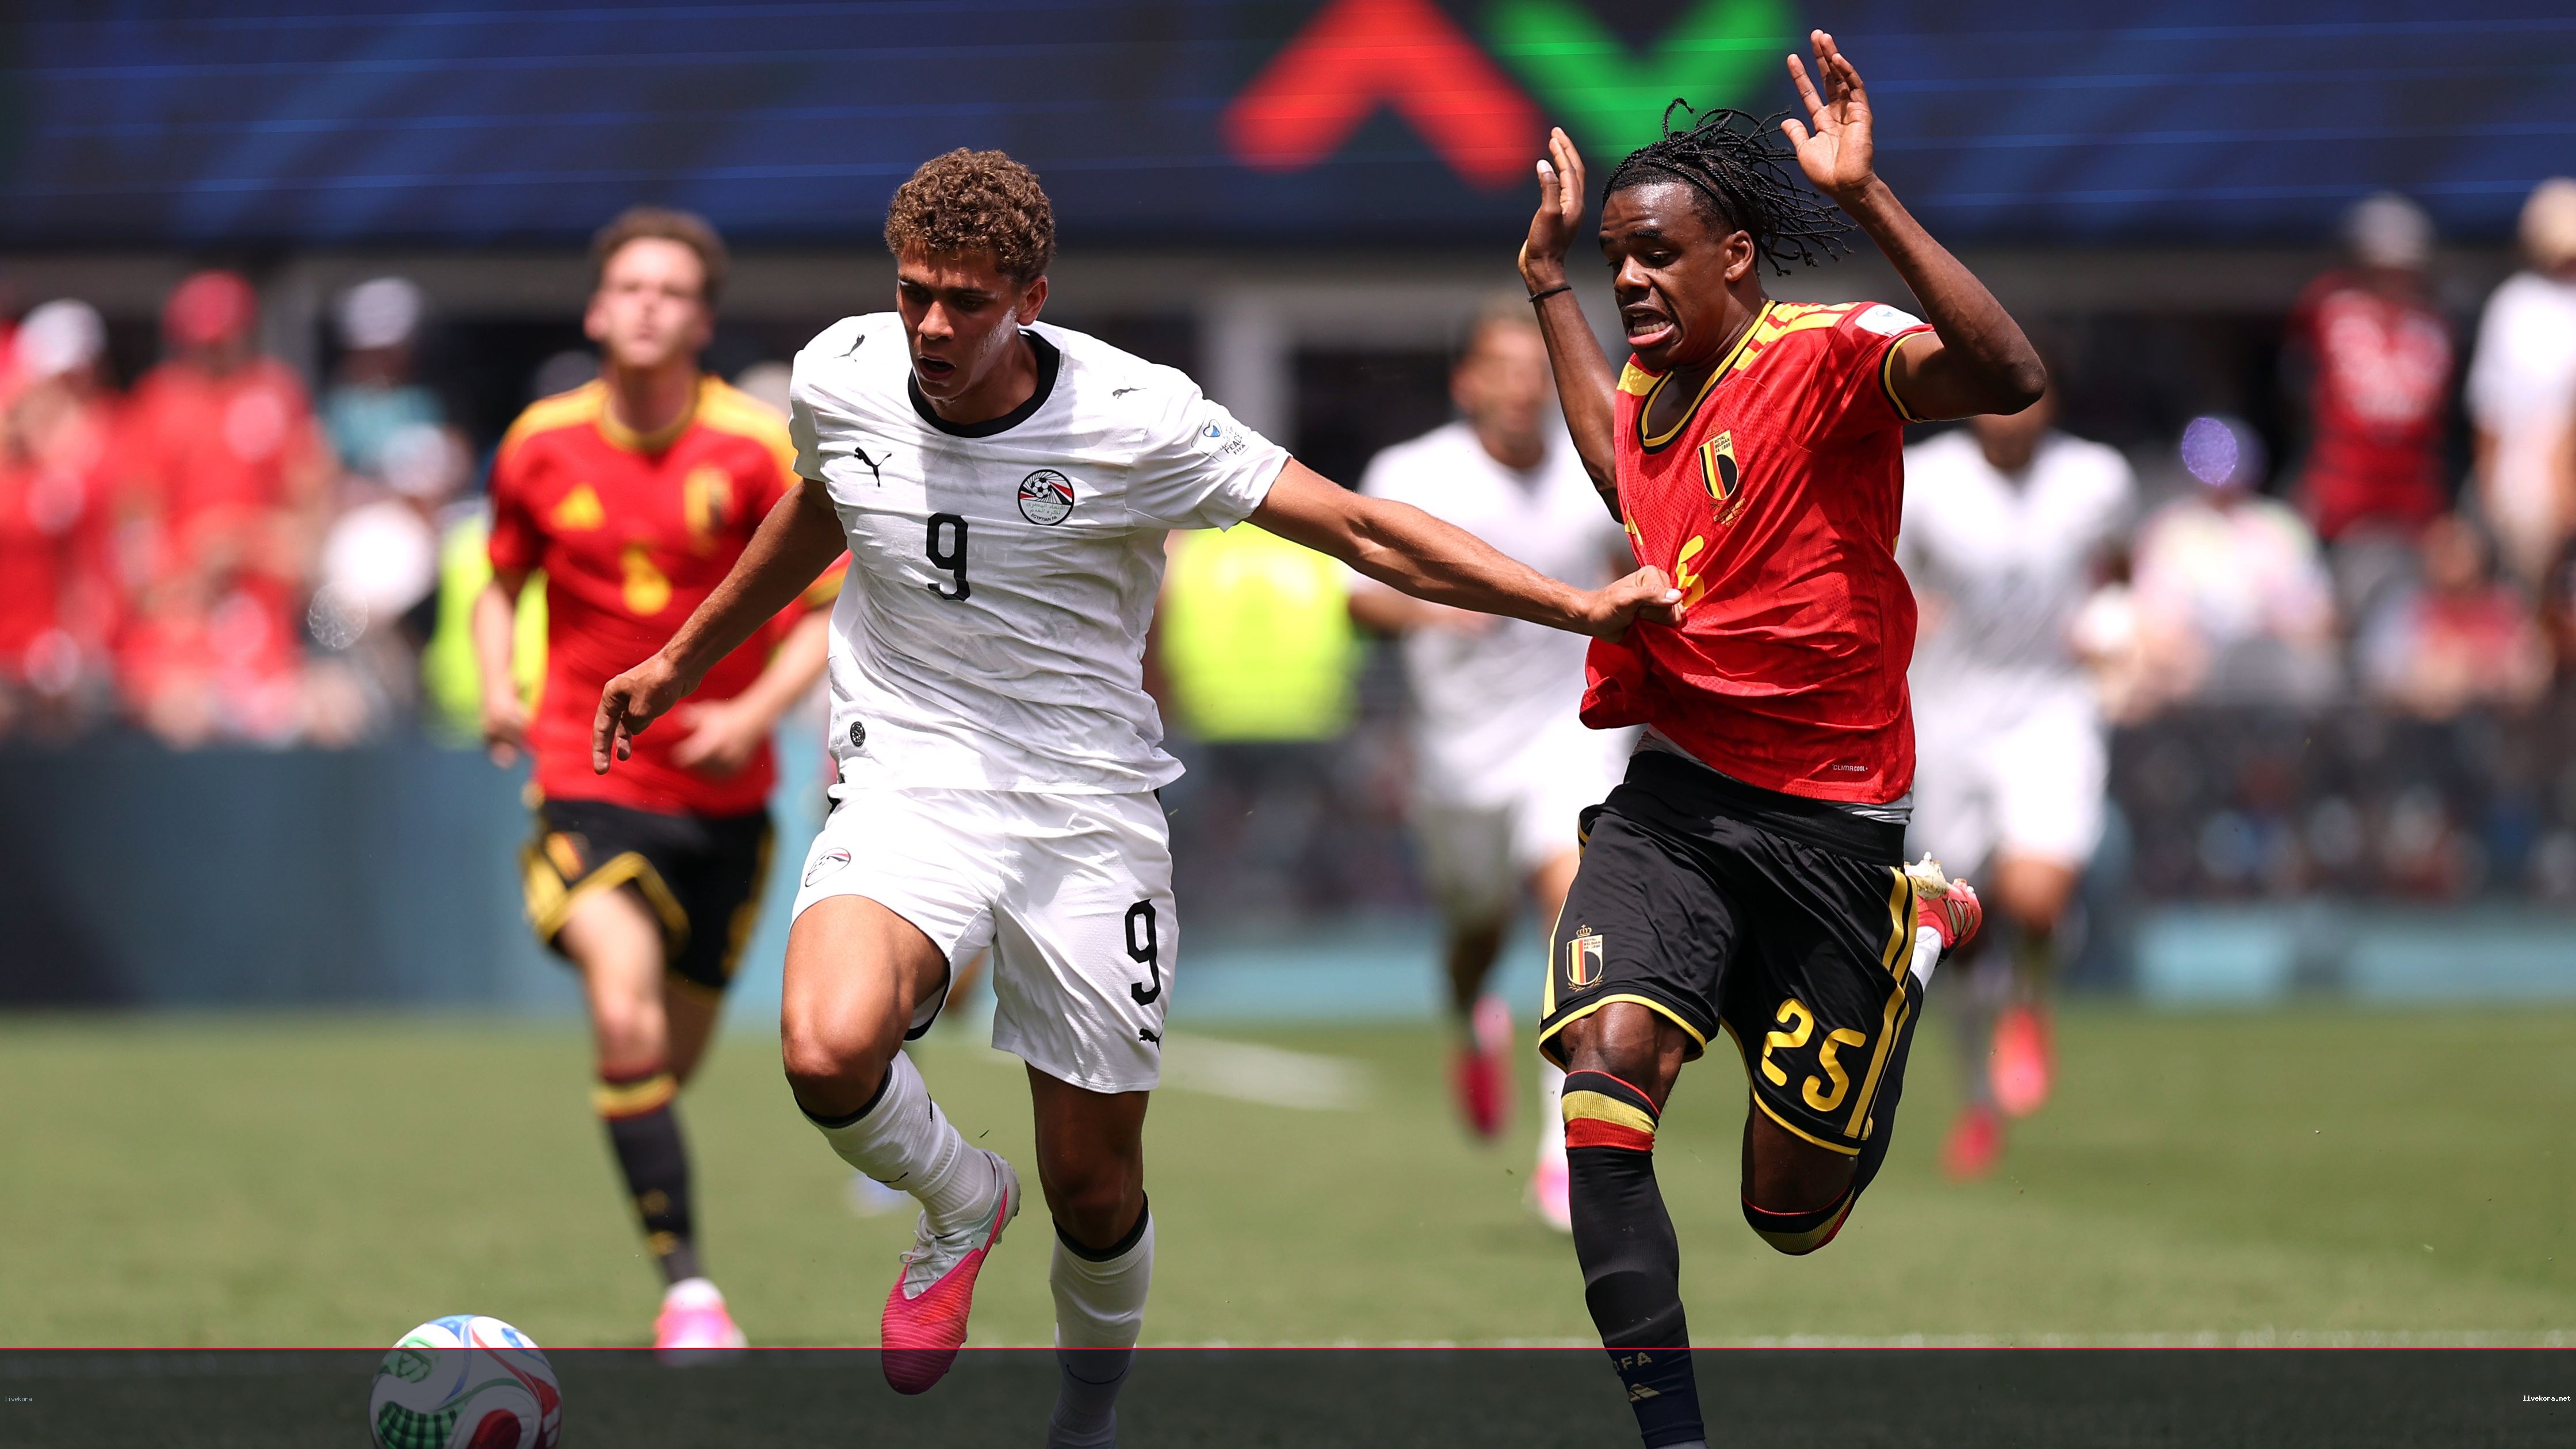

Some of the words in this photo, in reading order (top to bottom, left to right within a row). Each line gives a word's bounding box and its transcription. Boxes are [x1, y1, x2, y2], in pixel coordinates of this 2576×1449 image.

[1224, 431, 1243, 454] PEACE
[1715, 435, 1725, 444] ROYAL
[1715, 438, 1730, 449] BELGIAN
[1233, 444, 1245, 455] FIFA
[1031, 513, 1051, 521] EGYPTIAN
[926, 513, 970, 602] 9
[1125, 898, 1161, 1006] 9
[1761, 998, 1866, 1112] 25
